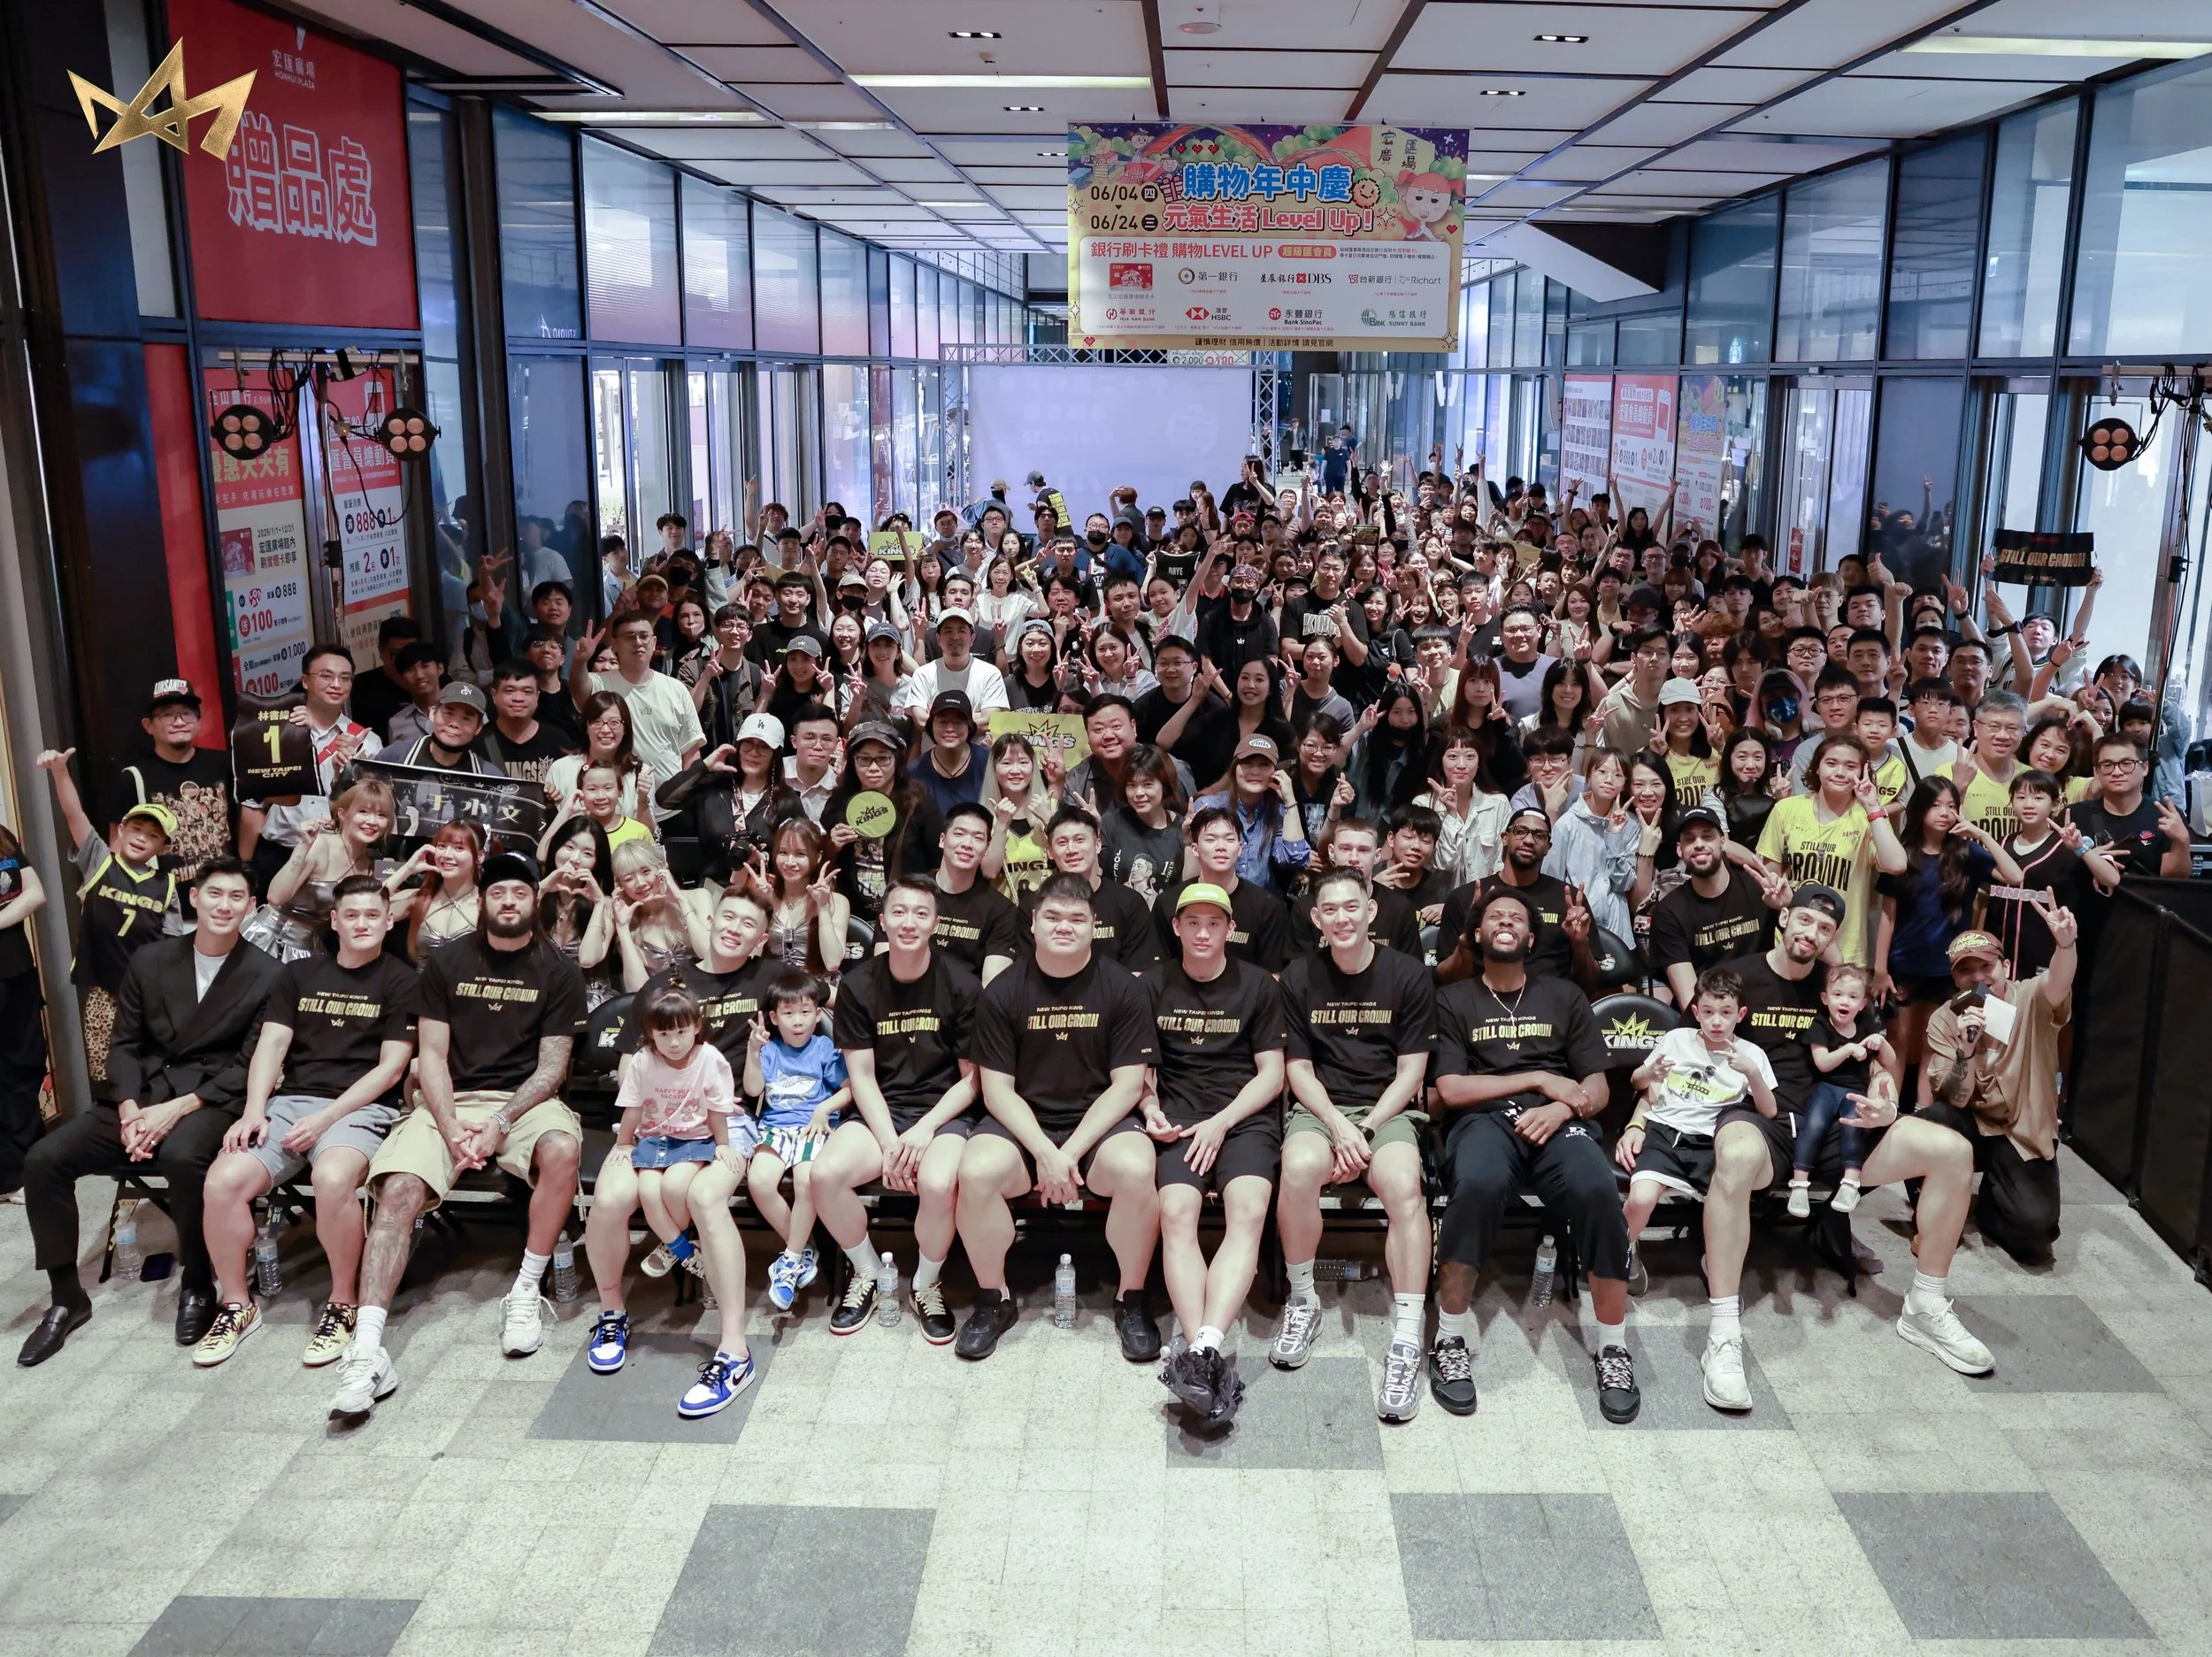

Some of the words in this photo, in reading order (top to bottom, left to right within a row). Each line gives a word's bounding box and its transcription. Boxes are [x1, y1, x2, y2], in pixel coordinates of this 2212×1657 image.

[225, 111, 378, 247] 贈品處
[1182, 163, 1353, 203] 購物年中慶
[1091, 184, 1139, 203] 06/04
[1091, 214, 1139, 231] 06/24
[1162, 203, 1259, 233] 元氣生活
[1262, 207, 1325, 232] Level
[1091, 242, 1168, 258] 銀行刷卡禮
[1252, 244, 1273, 258] UP
[1198, 271, 1238, 282] 第一銀行
[1307, 272, 1333, 285] DBS
[1359, 274, 1393, 285] 台新銀行
[1410, 275, 1441, 285] Richart
[1285, 310, 1323, 318] 永豐銀行
[1388, 310, 1427, 319] 陽信銀行
[1194, 337, 1226, 346] 謹慎理財
[1267, 338, 1300, 347] 活動詳情
[877, 547, 916, 556] KINS
[1998, 548, 2025, 566] STILL
[2026, 550, 2047, 567] OUR
[2047, 551, 2086, 568] CROWN
[363, 551, 372, 574] 2
[282, 582, 297, 598] 888
[251, 608, 273, 633] 100
[288, 641, 306, 660] 1,000
[263, 725, 281, 764] 1
[267, 765, 302, 774] TAIPEI
[1692, 775, 1706, 785] OUR
[855, 806, 889, 826] KINGS
[1984, 806, 2001, 817] STILL
[1800, 840, 1819, 852] STILL
[98, 886, 165, 914] KINGS
[1990, 885, 2051, 903] KINGS
[117, 908, 137, 938] 7
[949, 924, 980, 940] CROWN
[1715, 927, 1731, 943] OUR
[455, 982, 482, 998] STILL
[481, 984, 503, 1000] OUR
[503, 986, 539, 1003] CROWN
[297, 998, 325, 1014] STILL
[325, 1000, 345, 1016] OUR
[344, 1001, 381, 1018] CROWN
[722, 998, 758, 1016] CROWN
[1048, 1014, 1067, 1029] OUR
[1067, 1013, 1100, 1029] CROWN
[1156, 1015, 1183, 1032] STILL
[1183, 1017, 1204, 1032] OUR
[1203, 1018, 1240, 1033] CROWN
[1310, 1009, 1337, 1024] STILL
[1338, 1009, 1358, 1024] OUR
[1357, 1009, 1393, 1024] CROWN
[1750, 1013, 1778, 1028] STILL
[1778, 1014, 1795, 1028] OUR
[877, 1019, 900, 1036] STILL
[1472, 1026, 1497, 1042] STILL
[1498, 1024, 1517, 1039] OUR
[1517, 1024, 1552, 1038] CROWN
[1602, 1034, 1665, 1050] KINGS
